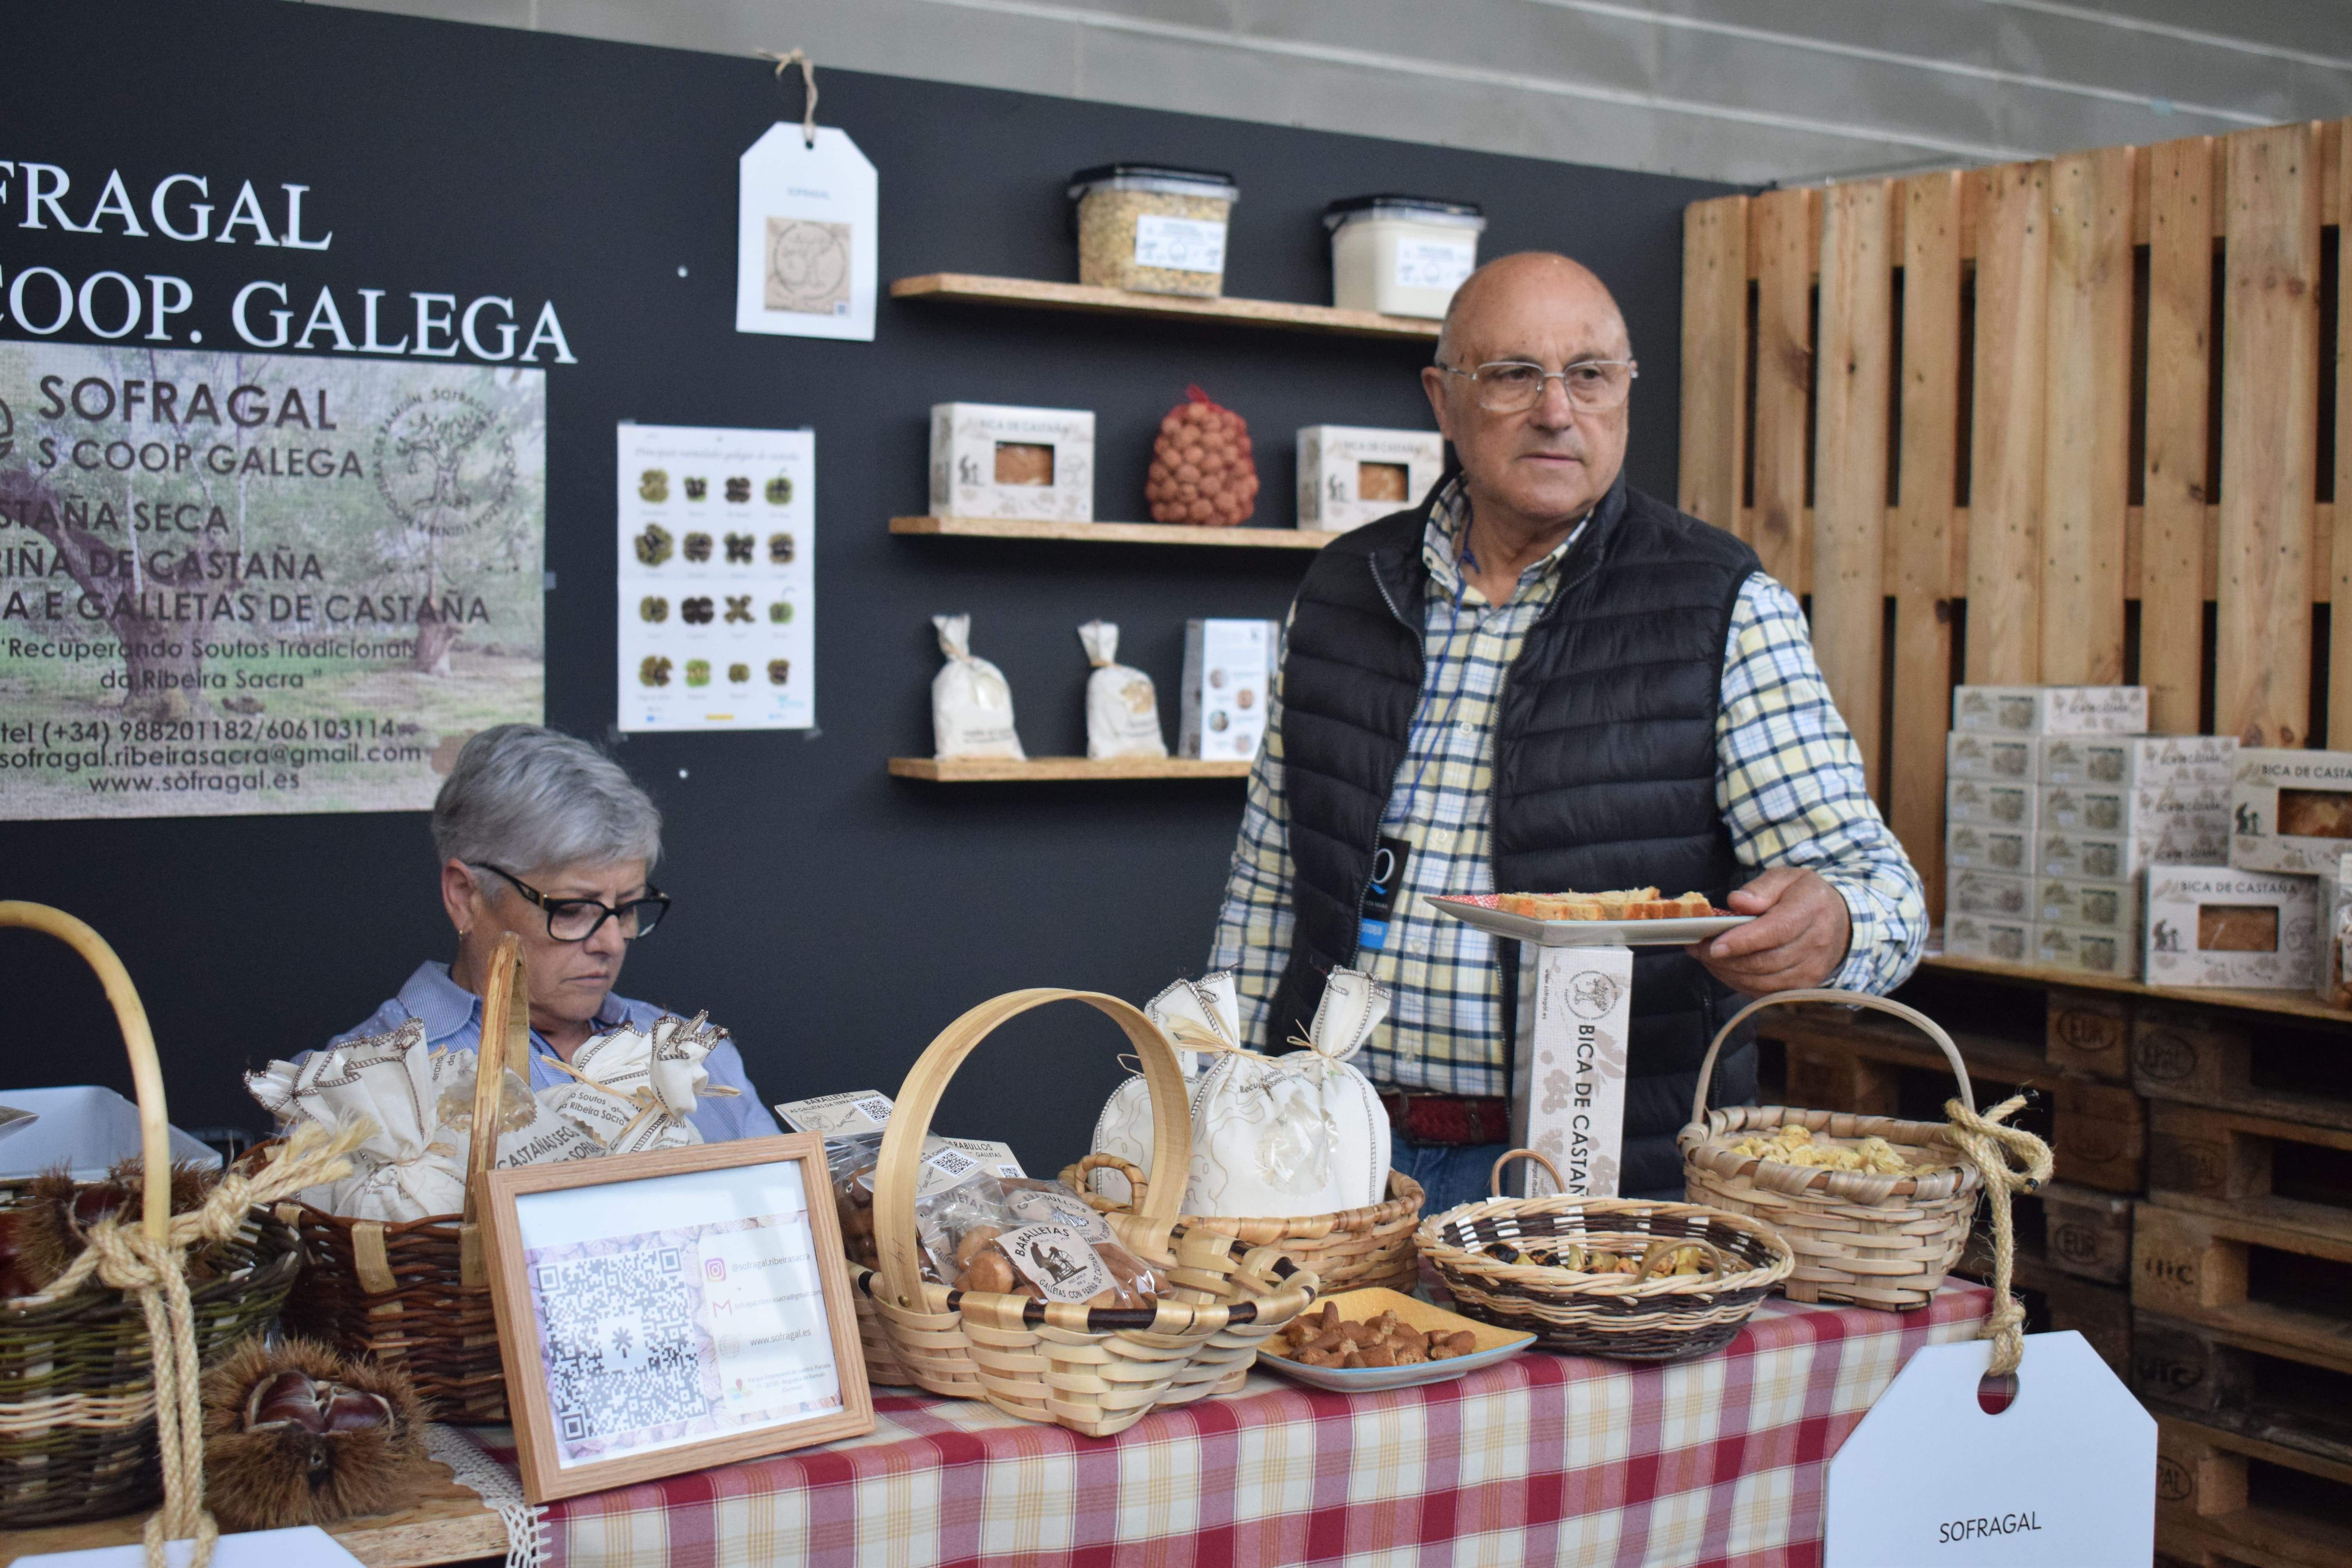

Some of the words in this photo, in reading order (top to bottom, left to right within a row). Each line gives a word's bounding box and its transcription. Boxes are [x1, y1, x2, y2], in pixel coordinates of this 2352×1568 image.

[0, 264, 202, 344] OOP.
[232, 281, 578, 364] GALEGA
[39, 375, 336, 430] SOFRAGAL
[38, 437, 56, 469] S
[72, 439, 192, 472] COOP
[207, 445, 365, 479] GALEGA
[134, 501, 229, 534] SECA
[0, 540, 74, 577] IÑA
[91, 550, 134, 577] DE
[149, 545, 324, 581] CASTAÑA
[2, 590, 29, 620] A
[45, 592, 62, 620] E
[77, 592, 256, 622] GALLETAS
[270, 594, 312, 622] DE
[325, 588, 490, 623] CASTAÑA
[191, 638, 269, 659] Soutos
[101, 669, 130, 689] da
[143, 669, 227, 689] Ribeira
[235, 669, 304, 689] Sacra
[1, 722, 33, 743] tel
[43, 721, 110, 748] (+34)
[120, 720, 394, 742] 988201182/606103114
[0, 744, 421, 772] sofragal.ribeirasacra@gmail.com
[2295, 765, 2309, 775] DE
[89, 771, 300, 793] www.sofragal.es
[2180, 881, 2210, 893] BICA
[2216, 882, 2232, 893] DE
[1576, 1024, 1595, 1074] BICA
[578, 1092, 606, 1105] Soutos
[804, 1093, 853, 1105] BARALLETAS
[1574, 1083, 1592, 1107] DE
[570, 1102, 600, 1116] Ribeira
[601, 1110, 624, 1126] Sacra
[798, 1104, 825, 1112] GALLETAS
[1015, 1227, 1069, 1257] BARALLETAS
[732, 1254, 810, 1272] @sofragal.ribeirasacra
[1039, 1279, 1066, 1298] GALLETAS
[1068, 1290, 1083, 1299] CON
[750, 1329, 811, 1346] www.sofragal.es
[1939, 1511, 2042, 1544] SOFRAGAL
